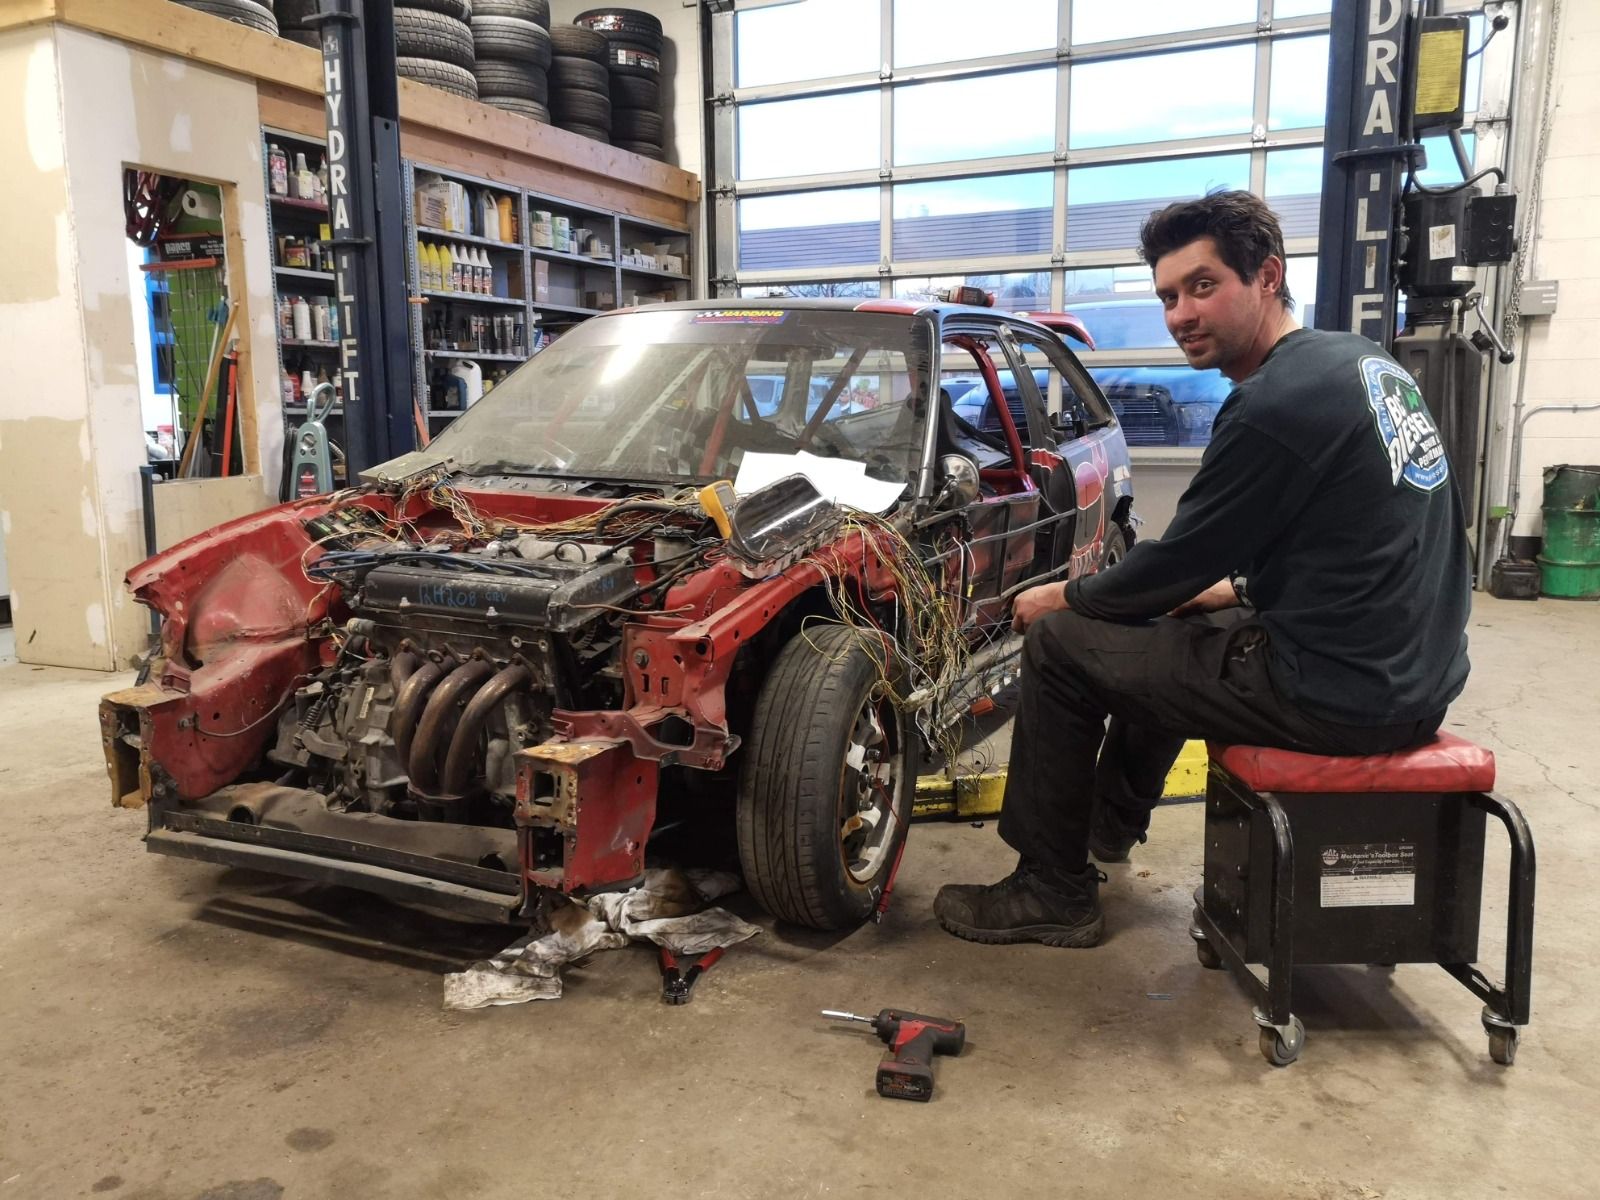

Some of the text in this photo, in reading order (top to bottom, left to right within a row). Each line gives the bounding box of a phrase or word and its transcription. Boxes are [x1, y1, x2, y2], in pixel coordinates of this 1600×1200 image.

[324, 59, 359, 400] HYDRA-LIFT
[1352, 0, 1400, 346] DRA-LIF
[1388, 411, 1435, 487] DIESEL
